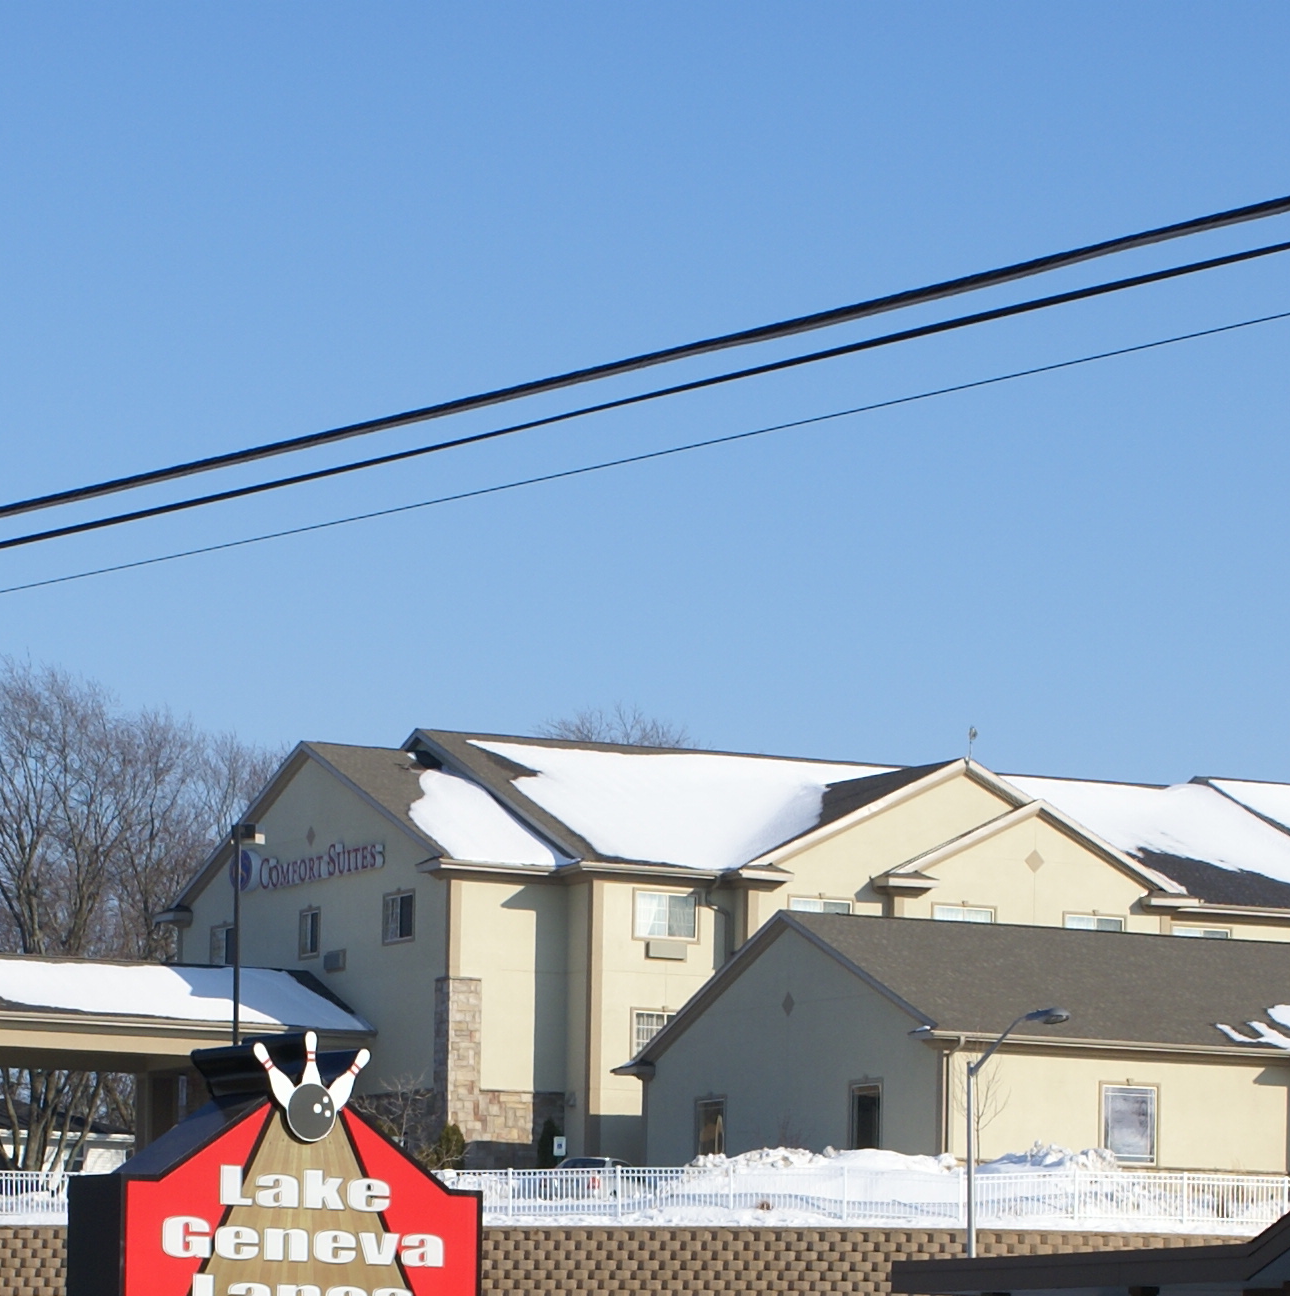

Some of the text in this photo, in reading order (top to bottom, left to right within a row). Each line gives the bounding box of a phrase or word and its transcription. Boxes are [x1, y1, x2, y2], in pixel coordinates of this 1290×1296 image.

[260, 856, 325, 889] COMFORT
[328, 843, 378, 876] SUITES
[220, 1164, 391, 1213] Lake
[161, 1216, 445, 1268] Geneva
